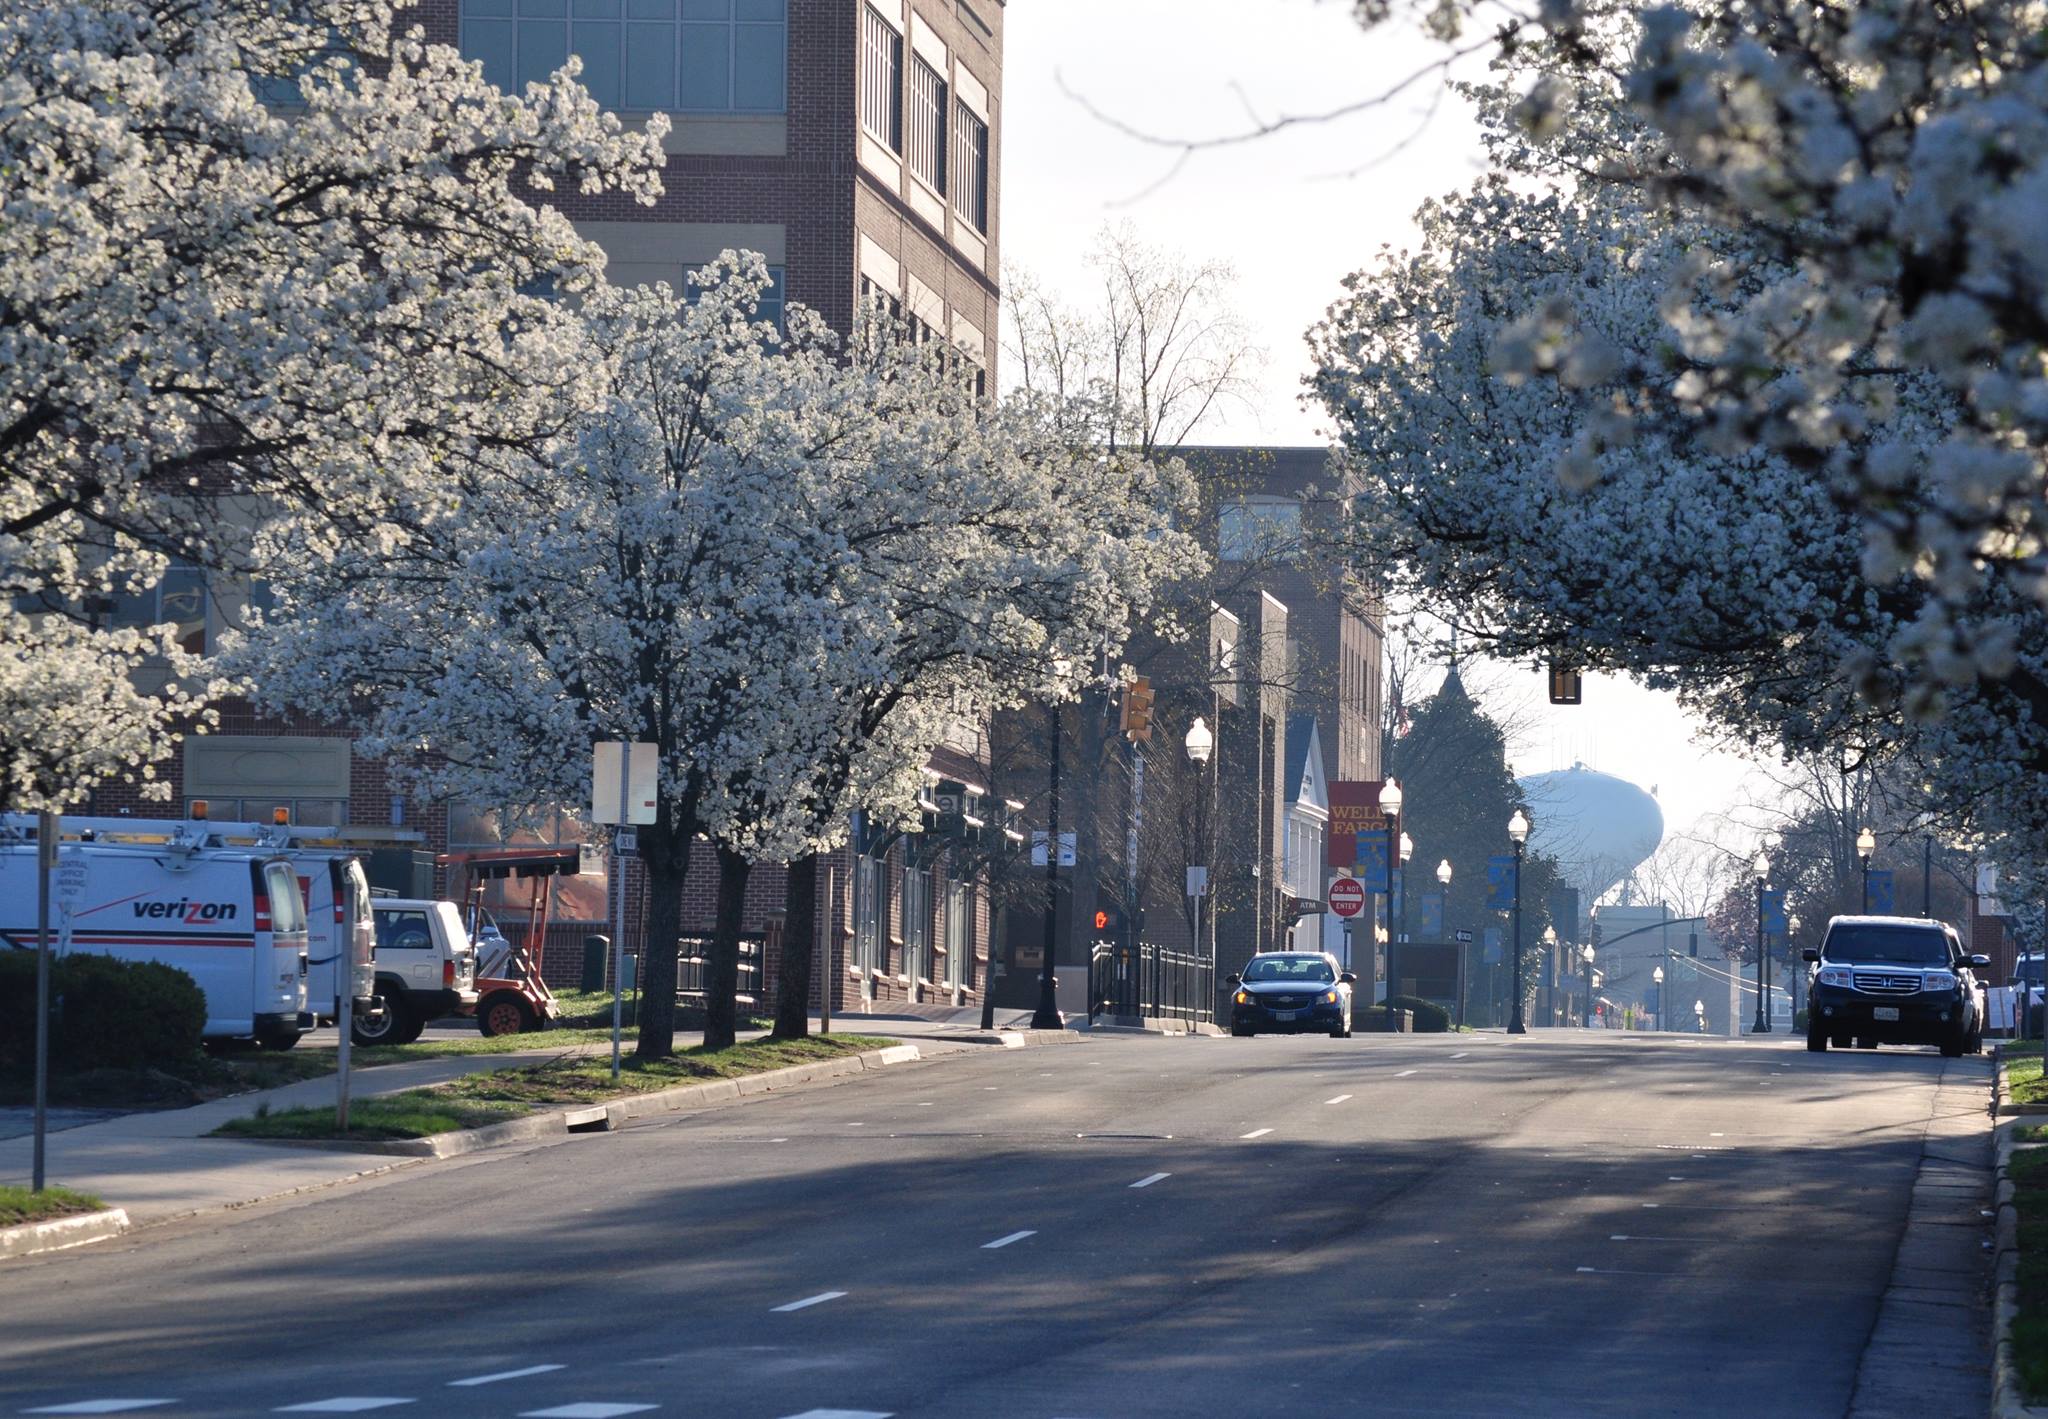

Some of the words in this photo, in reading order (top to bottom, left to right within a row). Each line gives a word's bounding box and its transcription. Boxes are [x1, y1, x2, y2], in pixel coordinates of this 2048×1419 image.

[1331, 806, 1389, 819] WELL
[133, 897, 237, 924] verizon
[1335, 902, 1357, 910] ENTER
